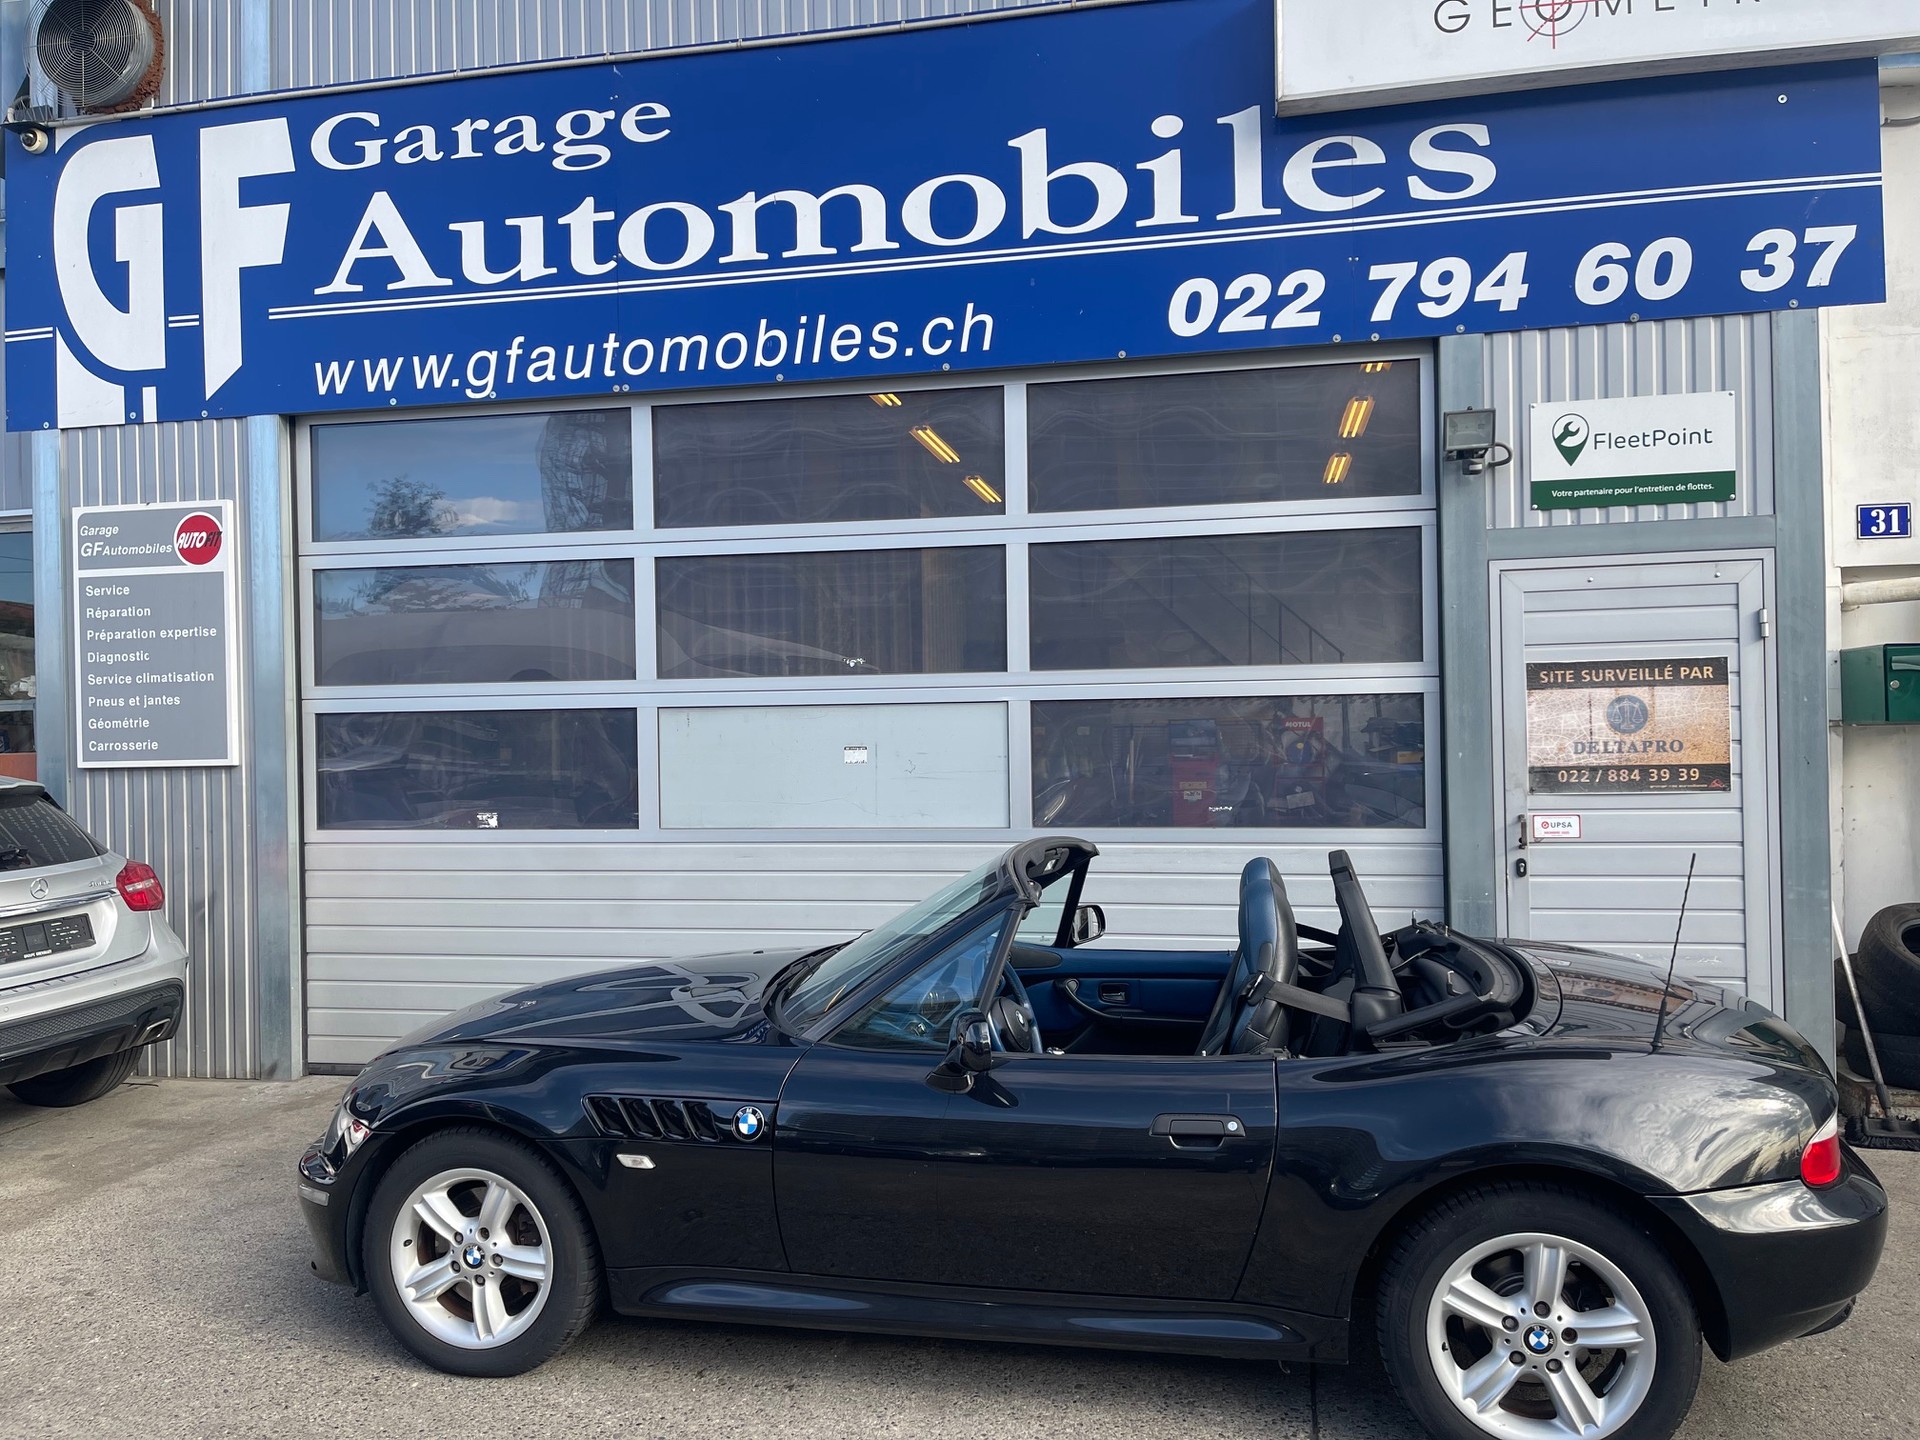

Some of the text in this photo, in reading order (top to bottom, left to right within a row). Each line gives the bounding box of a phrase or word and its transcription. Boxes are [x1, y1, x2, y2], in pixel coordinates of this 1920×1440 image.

[310, 102, 671, 171] Garage
[314, 104, 1498, 295] Automobiles
[53, 117, 296, 400] GF
[1168, 225, 1858, 337] 022 794 60 37
[314, 303, 994, 397] www.gfautomobiles.ch
[1594, 427, 1713, 450] FleetPoint
[1552, 489, 1572, 497] Votre
[1574, 487, 1613, 498] partenaire
[1615, 485, 1633, 495] pour
[1635, 483, 1674, 494] l'entretien
[1688, 482, 1714, 491] flottes.
[1870, 509, 1901, 533] 31
[80, 525, 119, 536] Garage
[86, 585, 130, 596] Service
[87, 606, 151, 619] Réparation
[87, 626, 217, 642] Préparation expertise
[87, 651, 150, 664] Diagnostic
[87, 671, 215, 685] Service climatisation
[1540, 665, 1714, 683] SITE SURVEILLÉ PAR
[88, 695, 181, 708] Pneus et jantes
[88, 717, 150, 729] Géométrie
[89, 740, 158, 751] Carrosserie
[1573, 739, 1684, 755] DELTAPRO
[1558, 770, 1590, 782] 022
[1608, 769, 1641, 781] 884
[1649, 769, 1670, 781] 39
[1678, 768, 1700, 780] 39
